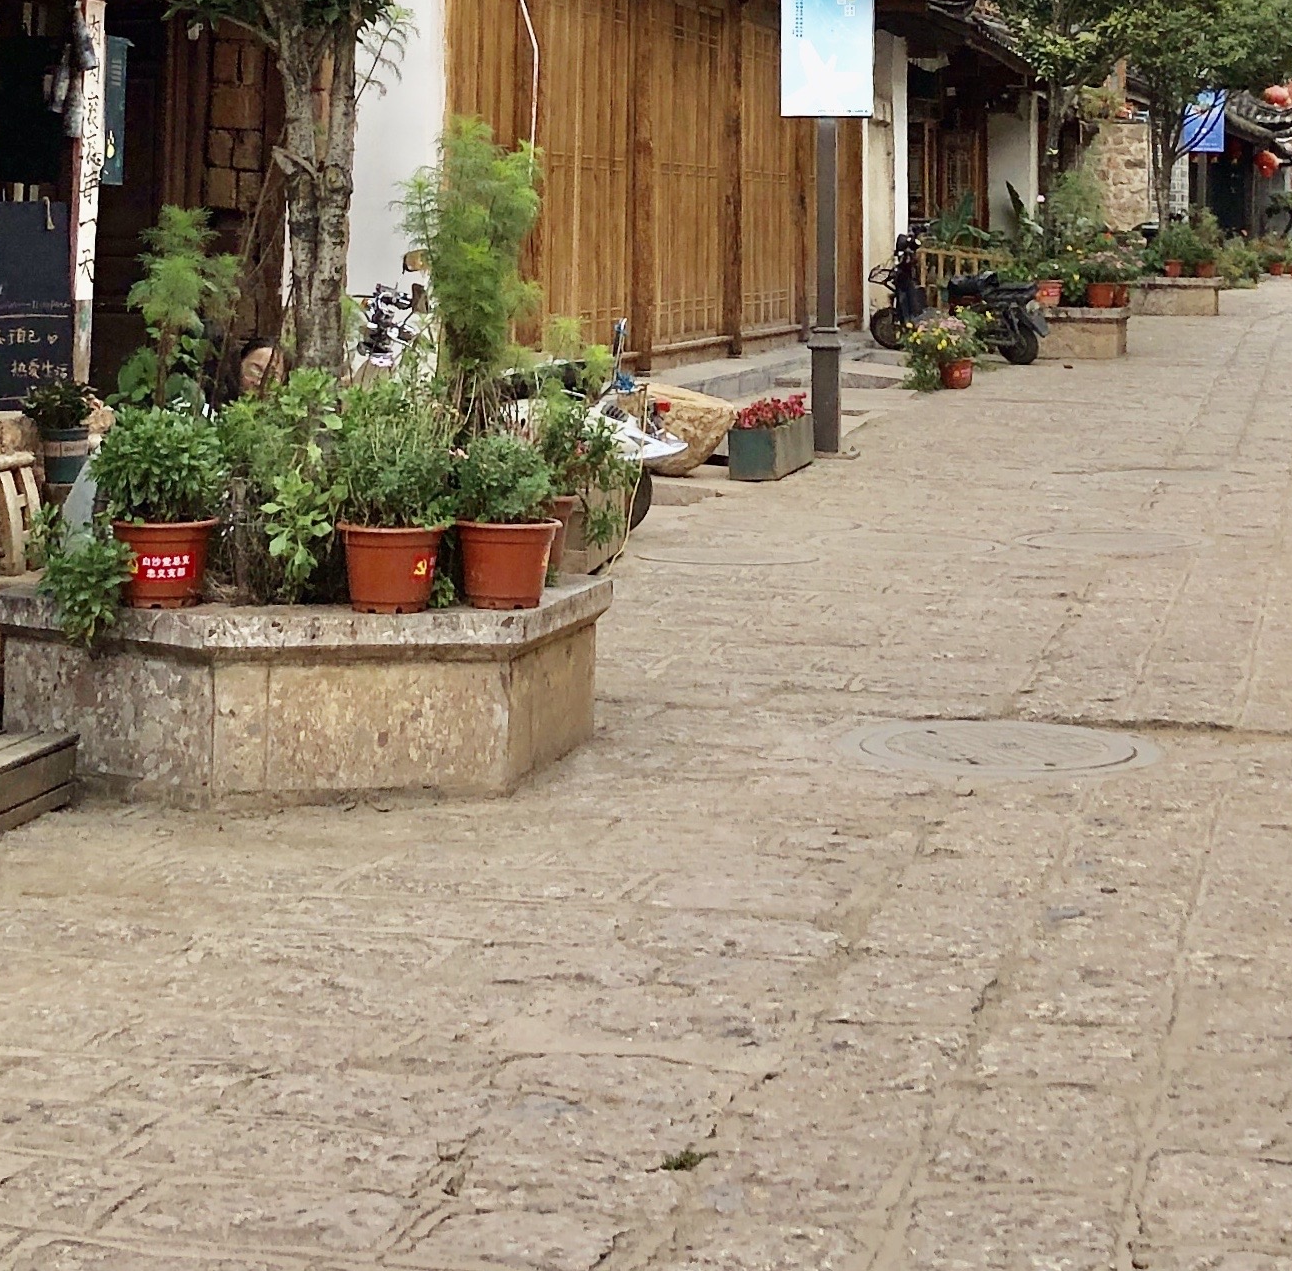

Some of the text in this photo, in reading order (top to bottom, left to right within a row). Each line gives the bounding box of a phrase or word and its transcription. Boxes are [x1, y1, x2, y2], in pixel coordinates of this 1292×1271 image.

[142, 555, 190, 567] 白沙党总支
[146, 567, 186, 579] 忠义支部
